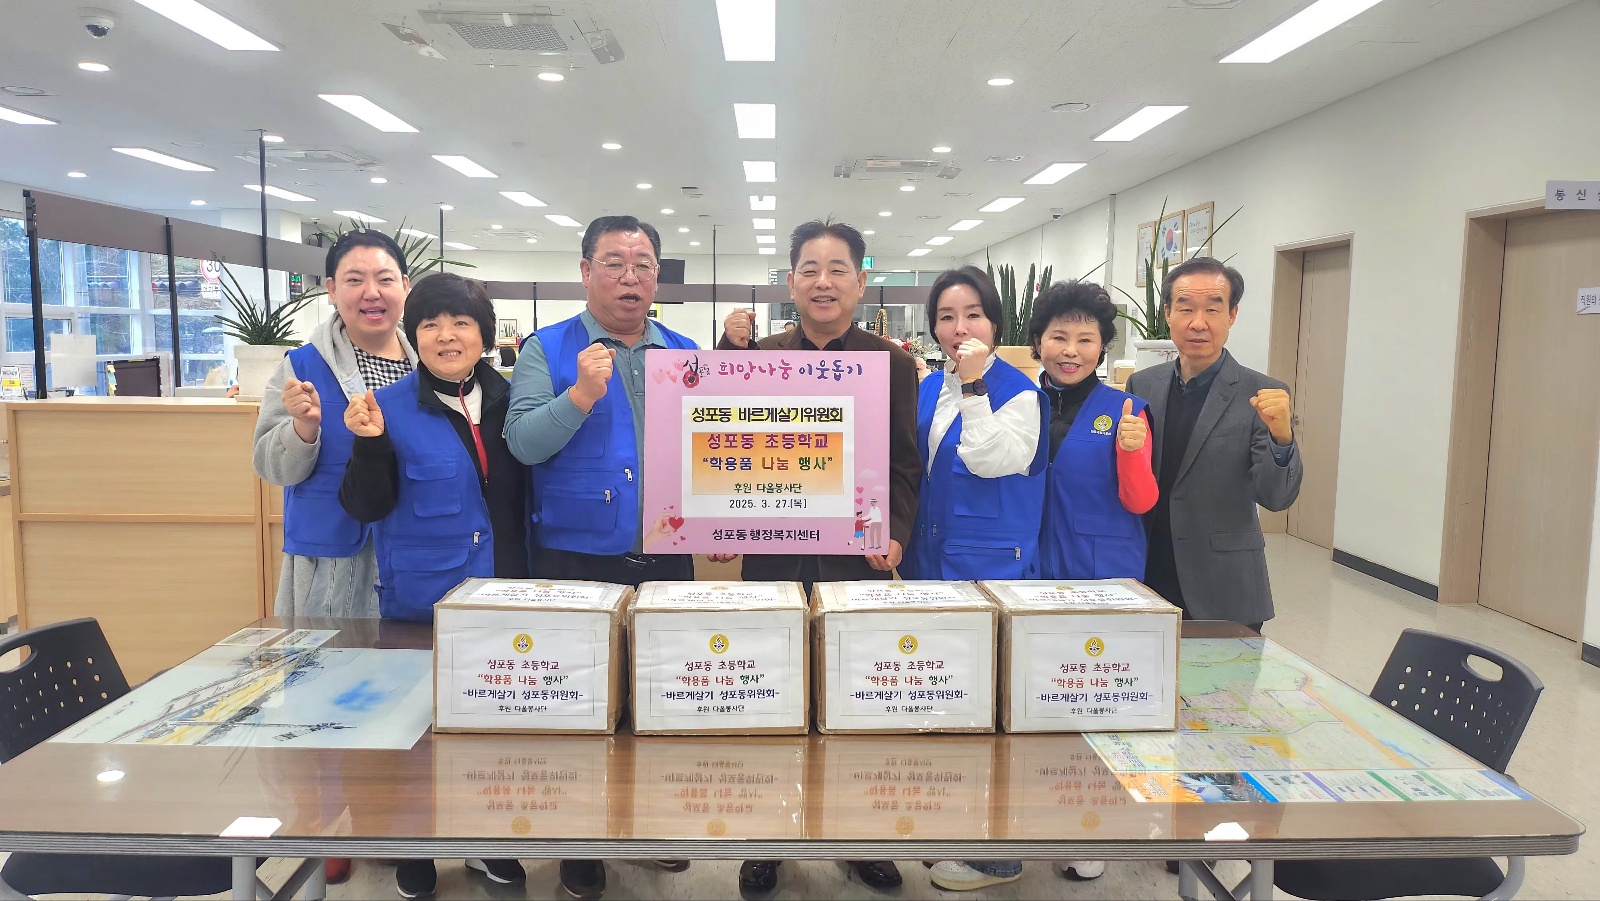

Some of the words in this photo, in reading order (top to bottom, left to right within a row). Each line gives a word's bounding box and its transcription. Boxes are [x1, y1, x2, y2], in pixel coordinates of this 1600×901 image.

[206, 260, 220, 272] 30
[718, 359, 793, 380] 희망나눔
[799, 359, 863, 381] 이웃돕기
[691, 407, 732, 422] 성포동
[738, 407, 843, 422] 바르게살기위원회
[707, 433, 755, 449] 성포동
[765, 433, 829, 449] 초등학교
[702, 456, 752, 471] “학용품
[761, 456, 789, 471] 나눔
[798, 456, 833, 471] 행사”
[734, 483, 752, 493] 후원
[756, 483, 803, 493] 다올봉사단
[729, 499, 757, 509] 2025.
[761, 499, 771, 509] 3.
[487, 659, 516, 670] 성포동
[521, 660, 560, 671] 초등학교
[685, 661, 713, 671] 성포동
[718, 660, 756, 671] 초등학교
[874, 661, 901, 671] 성포동
[906, 660, 945, 671] 초등학교
[1060, 663, 1087, 673] 성포동
[1092, 663, 1131, 673] 초등학교
[518, 675, 537, 686] 나눔
[715, 675, 734, 686] 나눔
[904, 675, 923, 686] 나눔
[1090, 678, 1109, 688] 나눔
[498, 705, 511, 713] 후원
[697, 705, 710, 713] 후원
[885, 705, 898, 713] 후원
